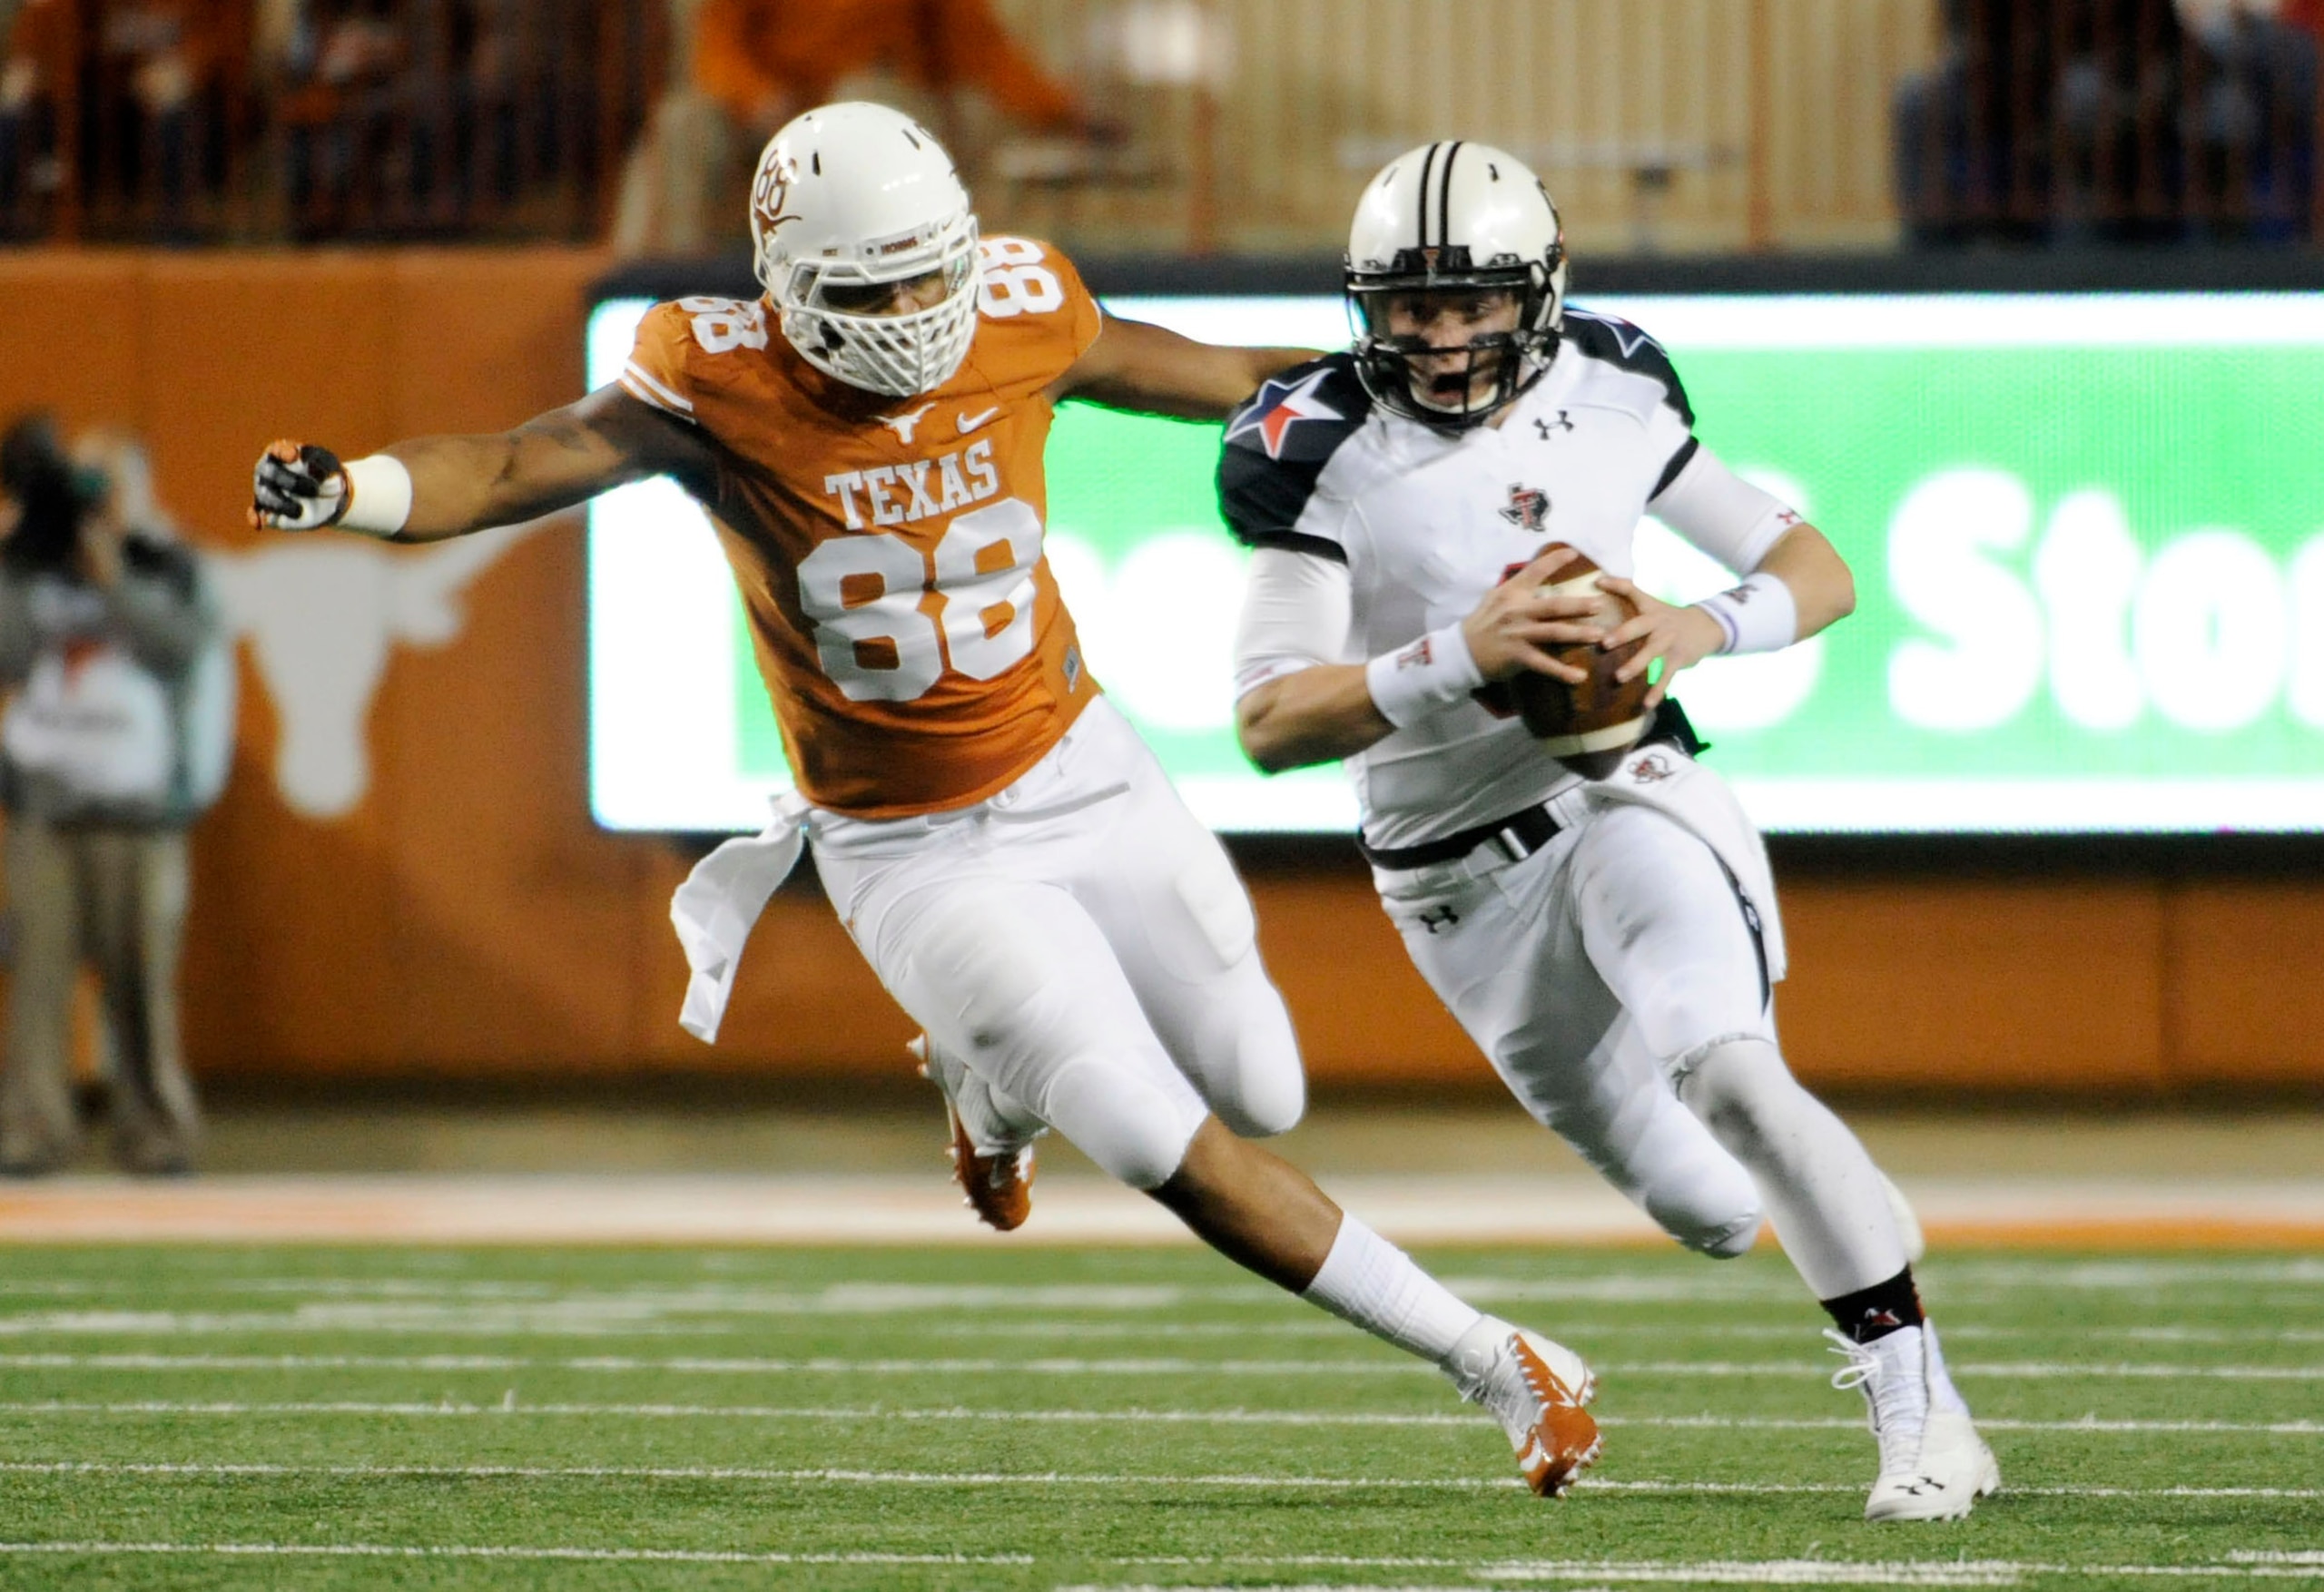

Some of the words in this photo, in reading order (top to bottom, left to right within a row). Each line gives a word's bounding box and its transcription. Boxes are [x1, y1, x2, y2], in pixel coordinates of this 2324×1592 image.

[757, 149, 797, 218] 88
[977, 238, 1064, 318] 88
[679, 296, 769, 355] 88
[823, 439, 998, 530] TEXAS
[796, 496, 1044, 702] 88
